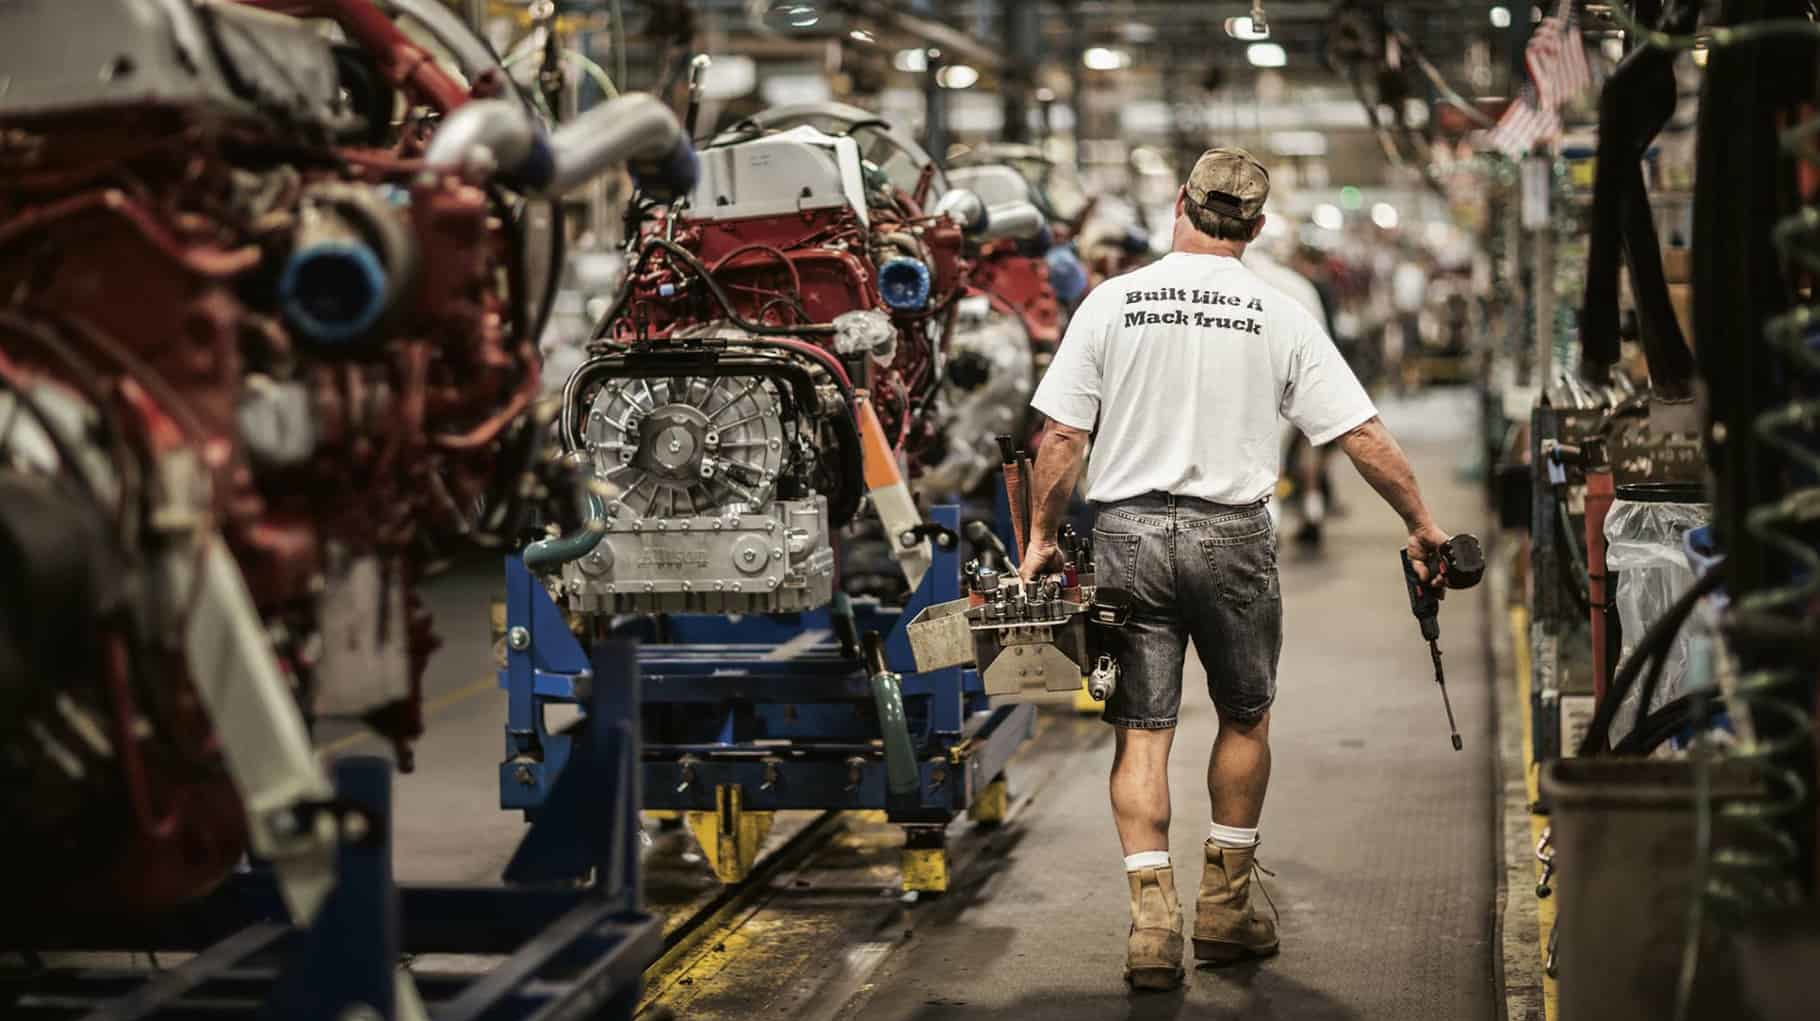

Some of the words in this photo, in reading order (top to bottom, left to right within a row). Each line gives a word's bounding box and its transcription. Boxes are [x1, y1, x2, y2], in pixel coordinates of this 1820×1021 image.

[1125, 288, 1187, 305] Built
[1191, 289, 1241, 307] Like
[1246, 297, 1264, 312] A
[1124, 310, 1189, 328] Mack
[1193, 312, 1263, 335] Truck
